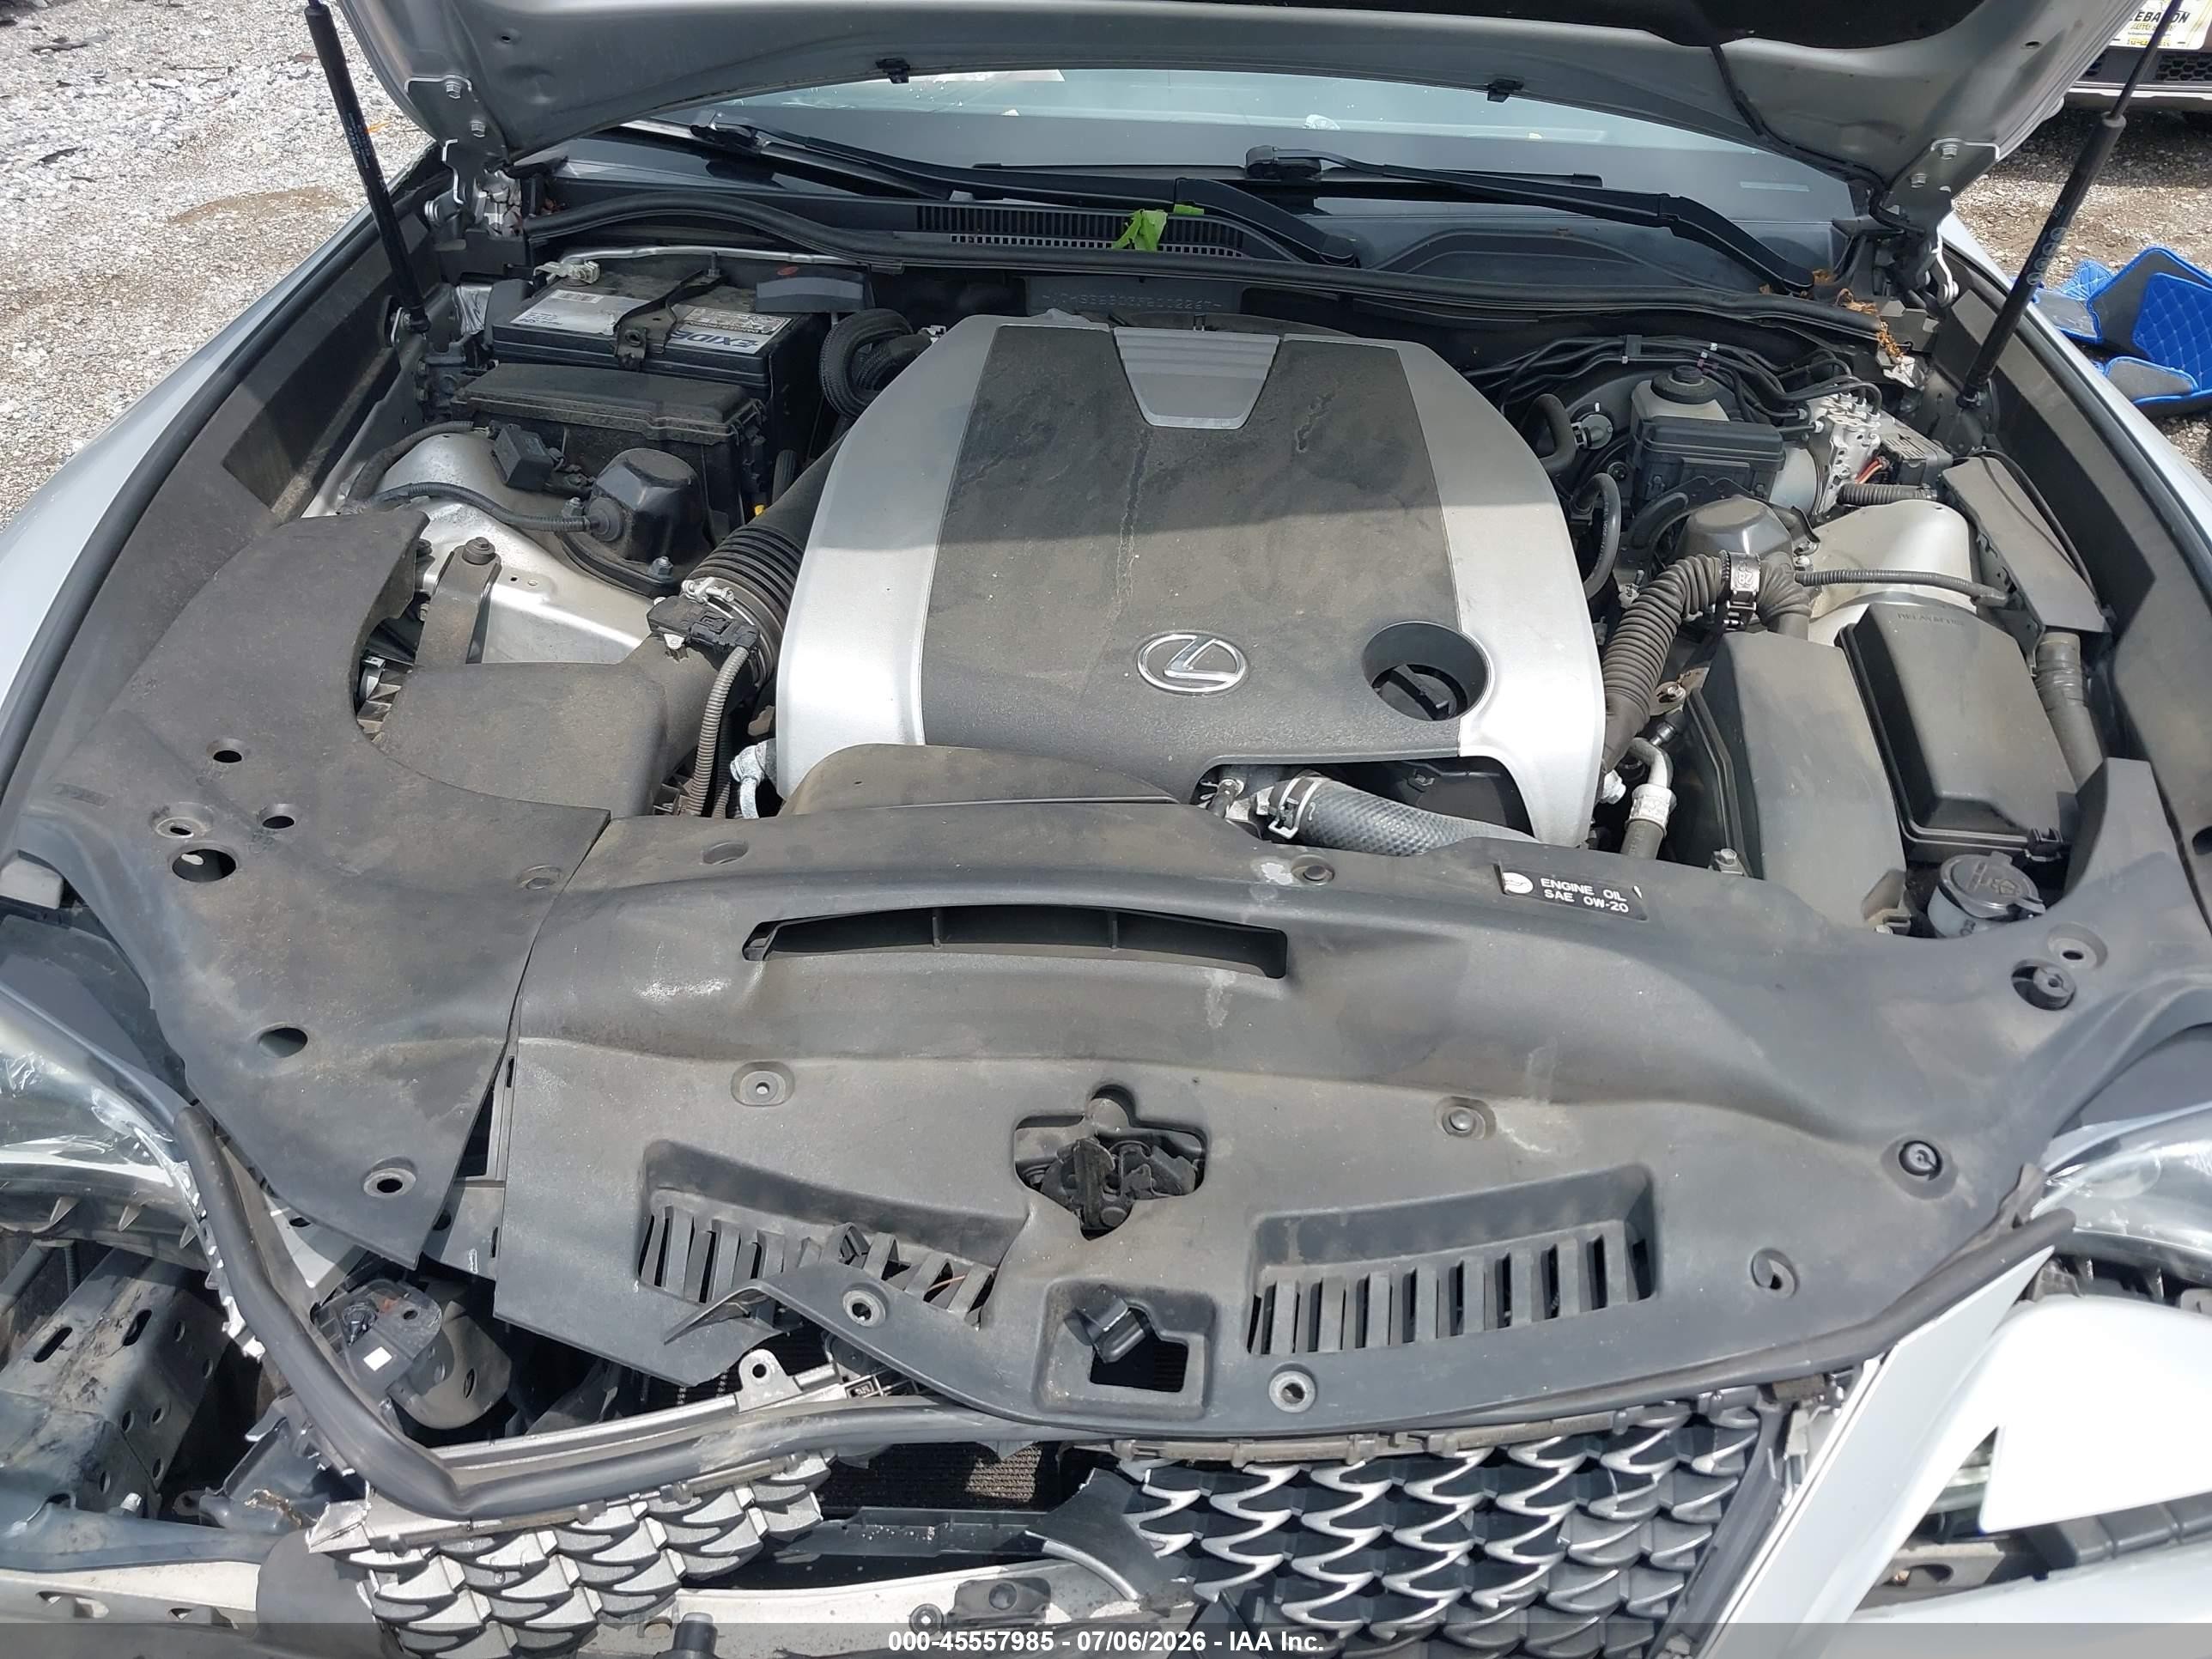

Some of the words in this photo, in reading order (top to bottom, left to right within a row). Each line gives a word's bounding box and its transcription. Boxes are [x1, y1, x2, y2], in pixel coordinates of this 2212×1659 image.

[2130, 11, 2191, 24] EBAON
[671, 329, 758, 349] EXIDE
[1540, 878, 1595, 896] ENGINE
[1603, 889, 1627, 902] OIL
[1544, 889, 1575, 903] SAE
[1583, 896, 1629, 913] 0W-20
